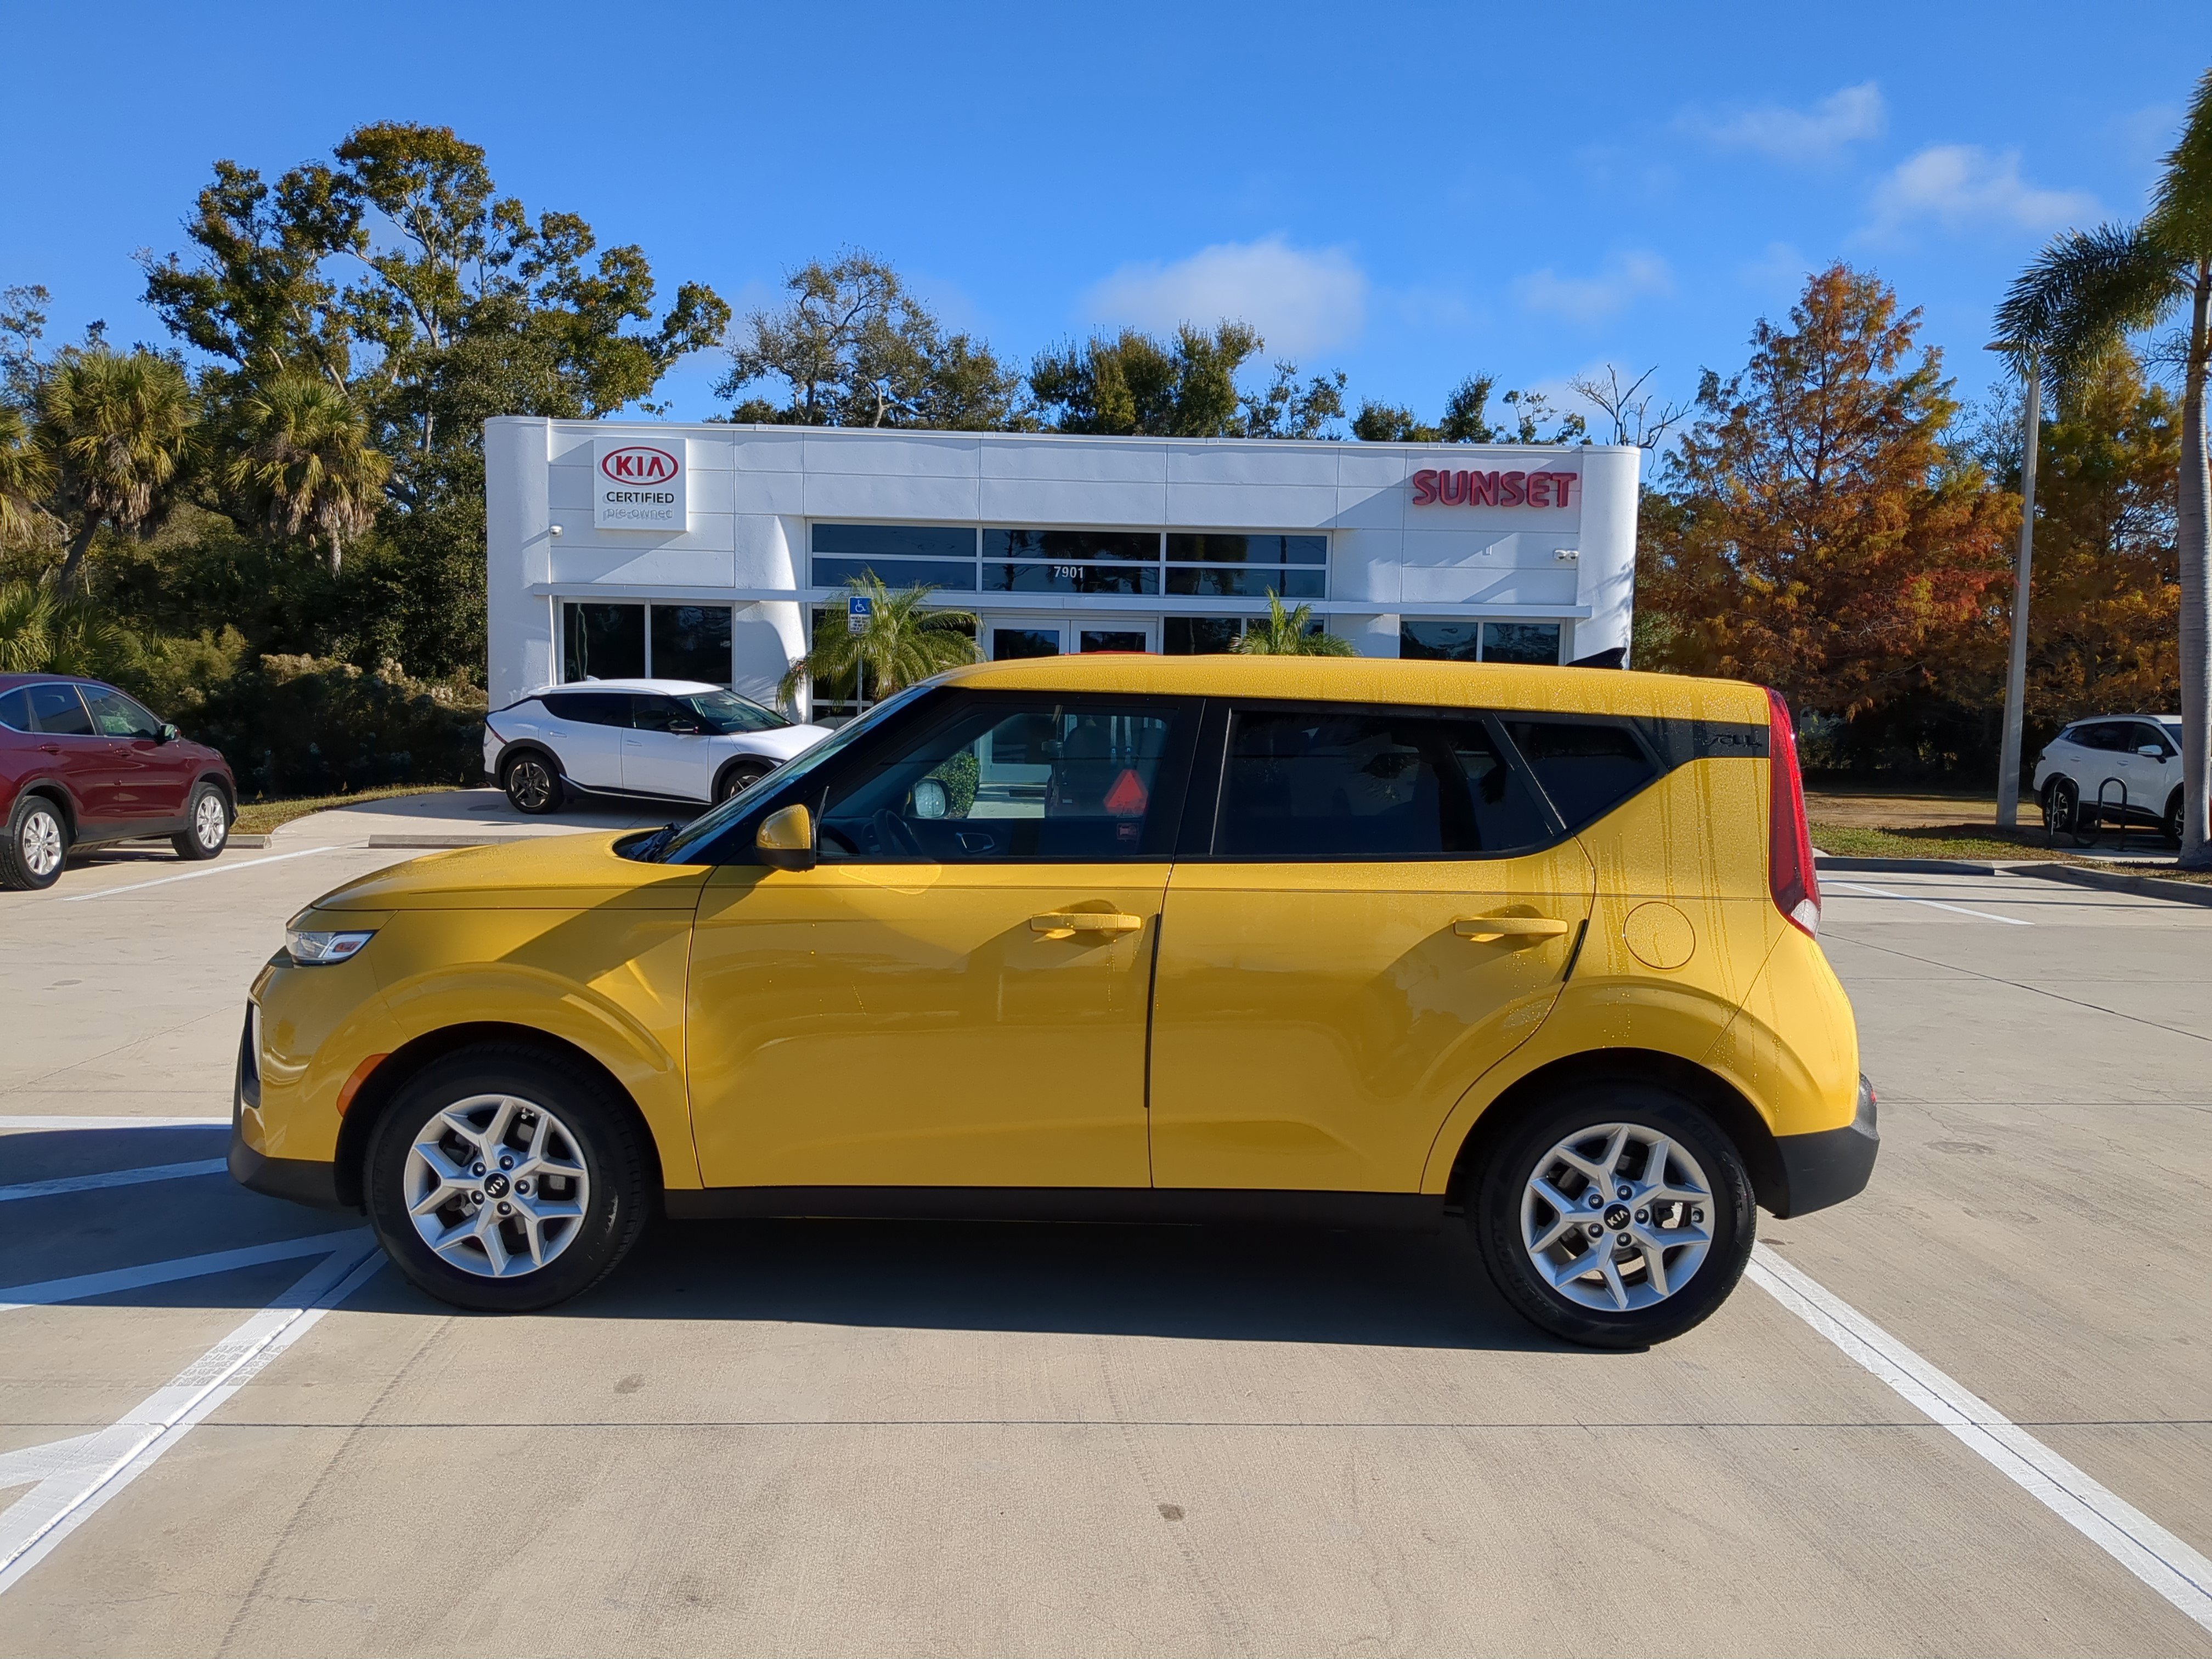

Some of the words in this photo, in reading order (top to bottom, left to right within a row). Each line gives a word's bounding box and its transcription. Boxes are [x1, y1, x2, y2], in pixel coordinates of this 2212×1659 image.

[615, 456, 665, 477] KIA
[1413, 470, 1578, 508] SUNSET
[606, 492, 674, 503] CERTIFIED
[607, 507, 673, 518] pre-owned
[1054, 566, 1084, 578] 7901
[1702, 733, 1763, 747] SOUL
[488, 1176, 505, 1194] KIA
[1607, 1210, 1628, 1226] KIA
